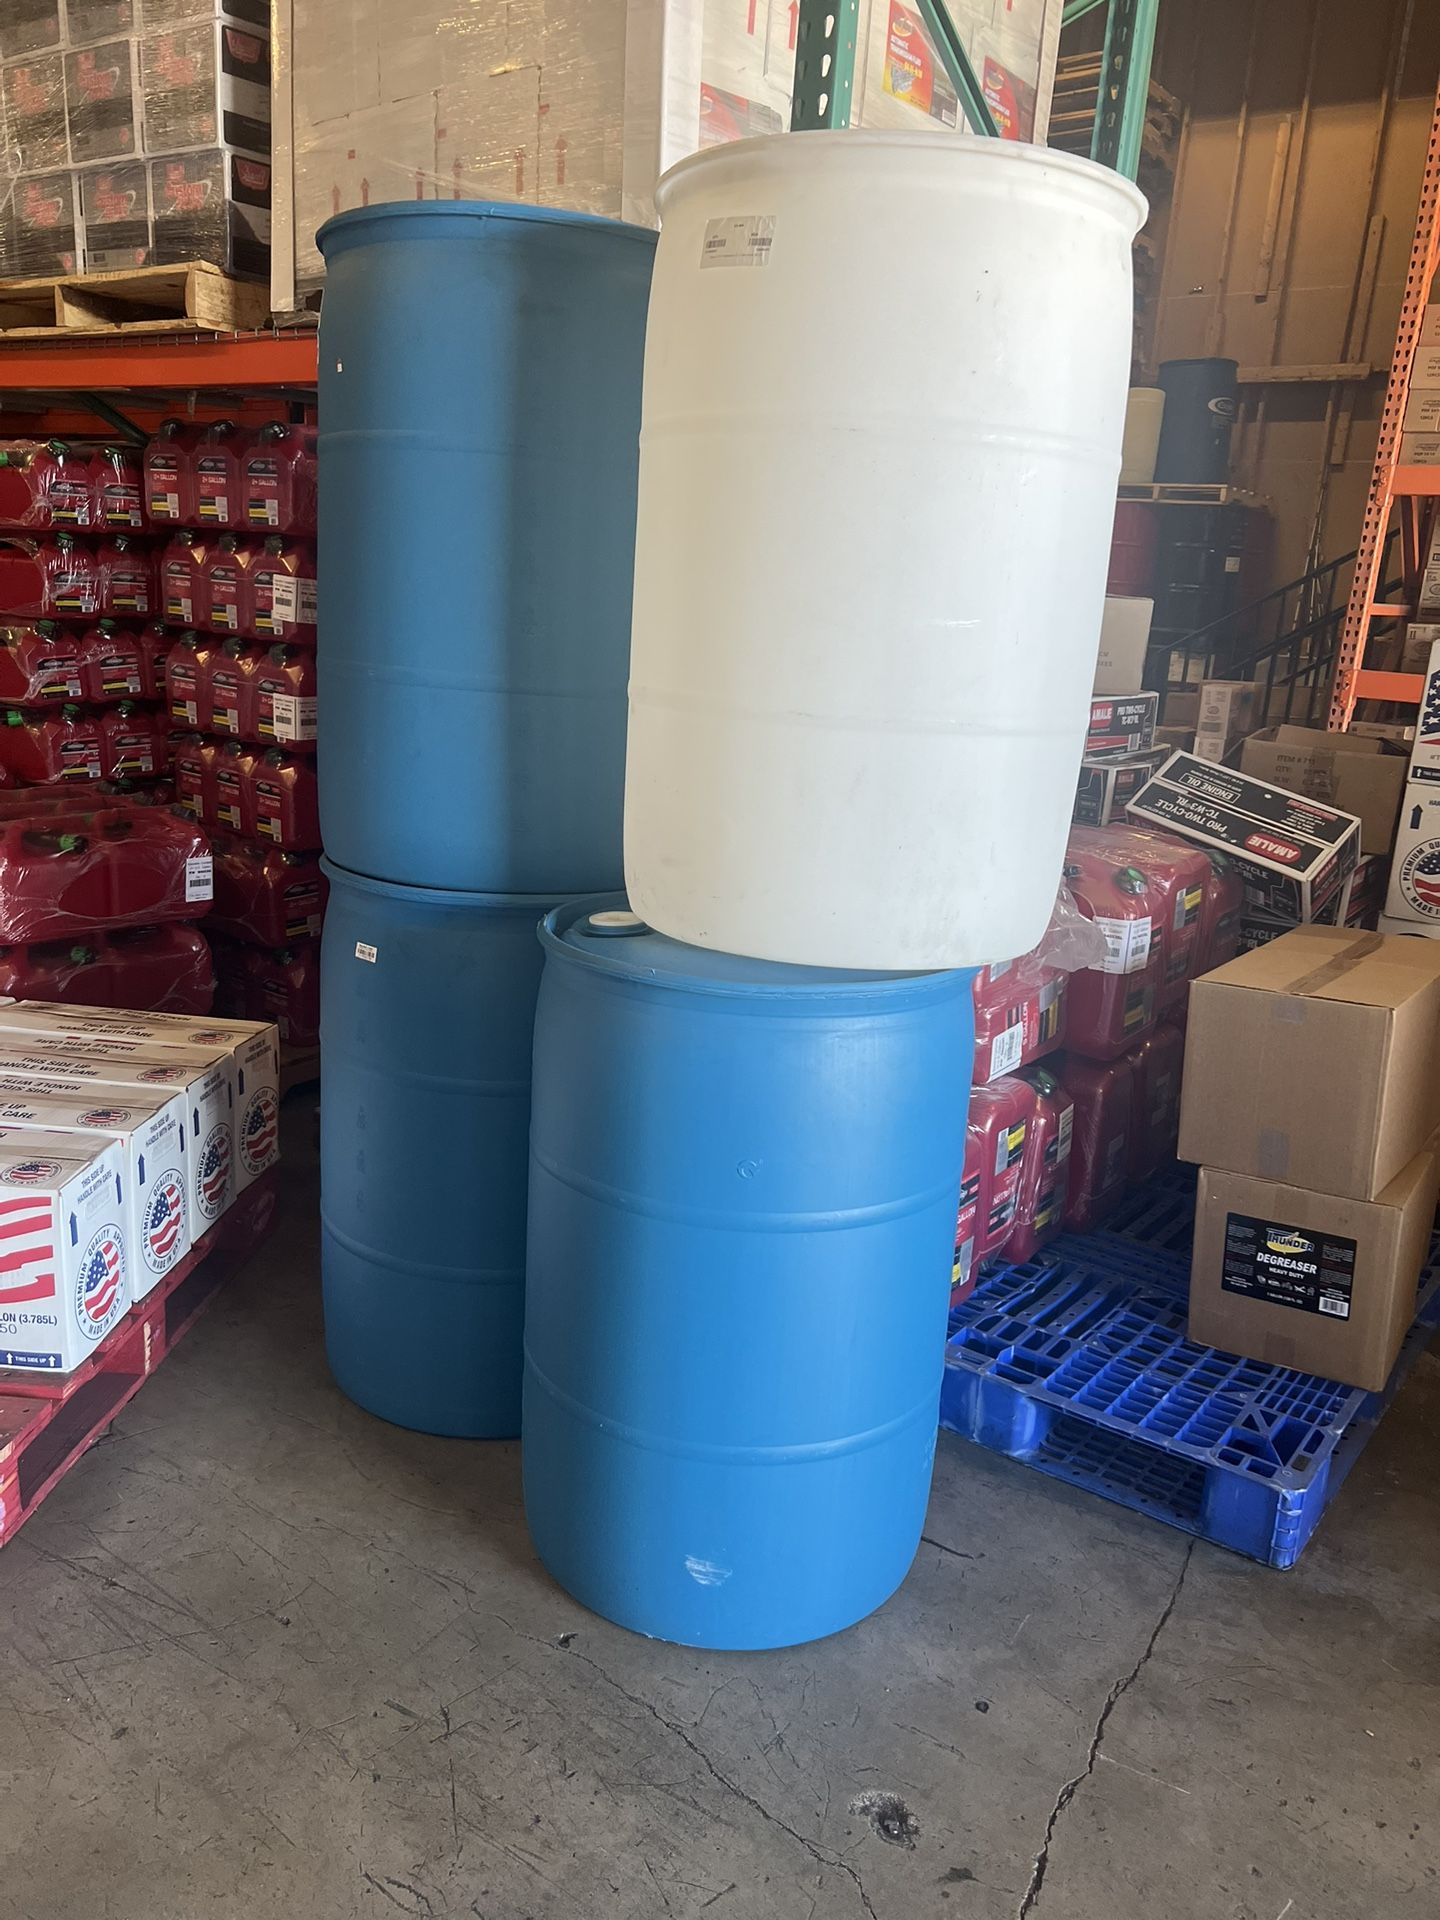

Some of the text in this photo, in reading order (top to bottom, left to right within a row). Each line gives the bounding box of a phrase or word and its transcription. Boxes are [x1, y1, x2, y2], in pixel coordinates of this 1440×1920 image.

[1186, 776, 1200, 786] OIL
[1200, 784, 1234, 800] ENGINE
[1155, 798, 1204, 825] TWO-CYCLE
[1206, 820, 1228, 832] PRO
[1248, 836, 1298, 859] AMALIE
[1403, 848, 1426, 882] PREMIUM
[1411, 896, 1432, 914] MADE
[126, 1030, 156, 1038] CARE
[92, 1043, 136, 1052] HANDLE
[40, 1065, 70, 1073] WITH
[34, 1082, 81, 1091] HANDLE
[2, 1110, 38, 1119] CARE
[146, 1119, 176, 1148] HANDLE WITH CARE
[150, 1122, 158, 1133] THIS
[82, 1176, 91, 1188] THIS
[91, 1169, 100, 1182] SIDE
[198, 1152, 206, 1196] PREMIUM
[78, 1169, 112, 1204] HANDLE WITH CARE
[144, 1202, 153, 1250] PREMIUM
[153, 1173, 172, 1196] QUALITY
[1266, 1228, 1315, 1252] THUNDER
[152, 1238, 181, 1270] MADE IN USA
[1256, 1252, 1318, 1274] DEGREASER
[78, 1262, 88, 1316] PREMIUM
[88, 1228, 110, 1257] QUALITY
[1268, 1266, 1305, 1280] HEAVY DUTY
[19, 1314, 58, 1326] (3.785L)
[88, 1298, 120, 1335] MADE IN USA
